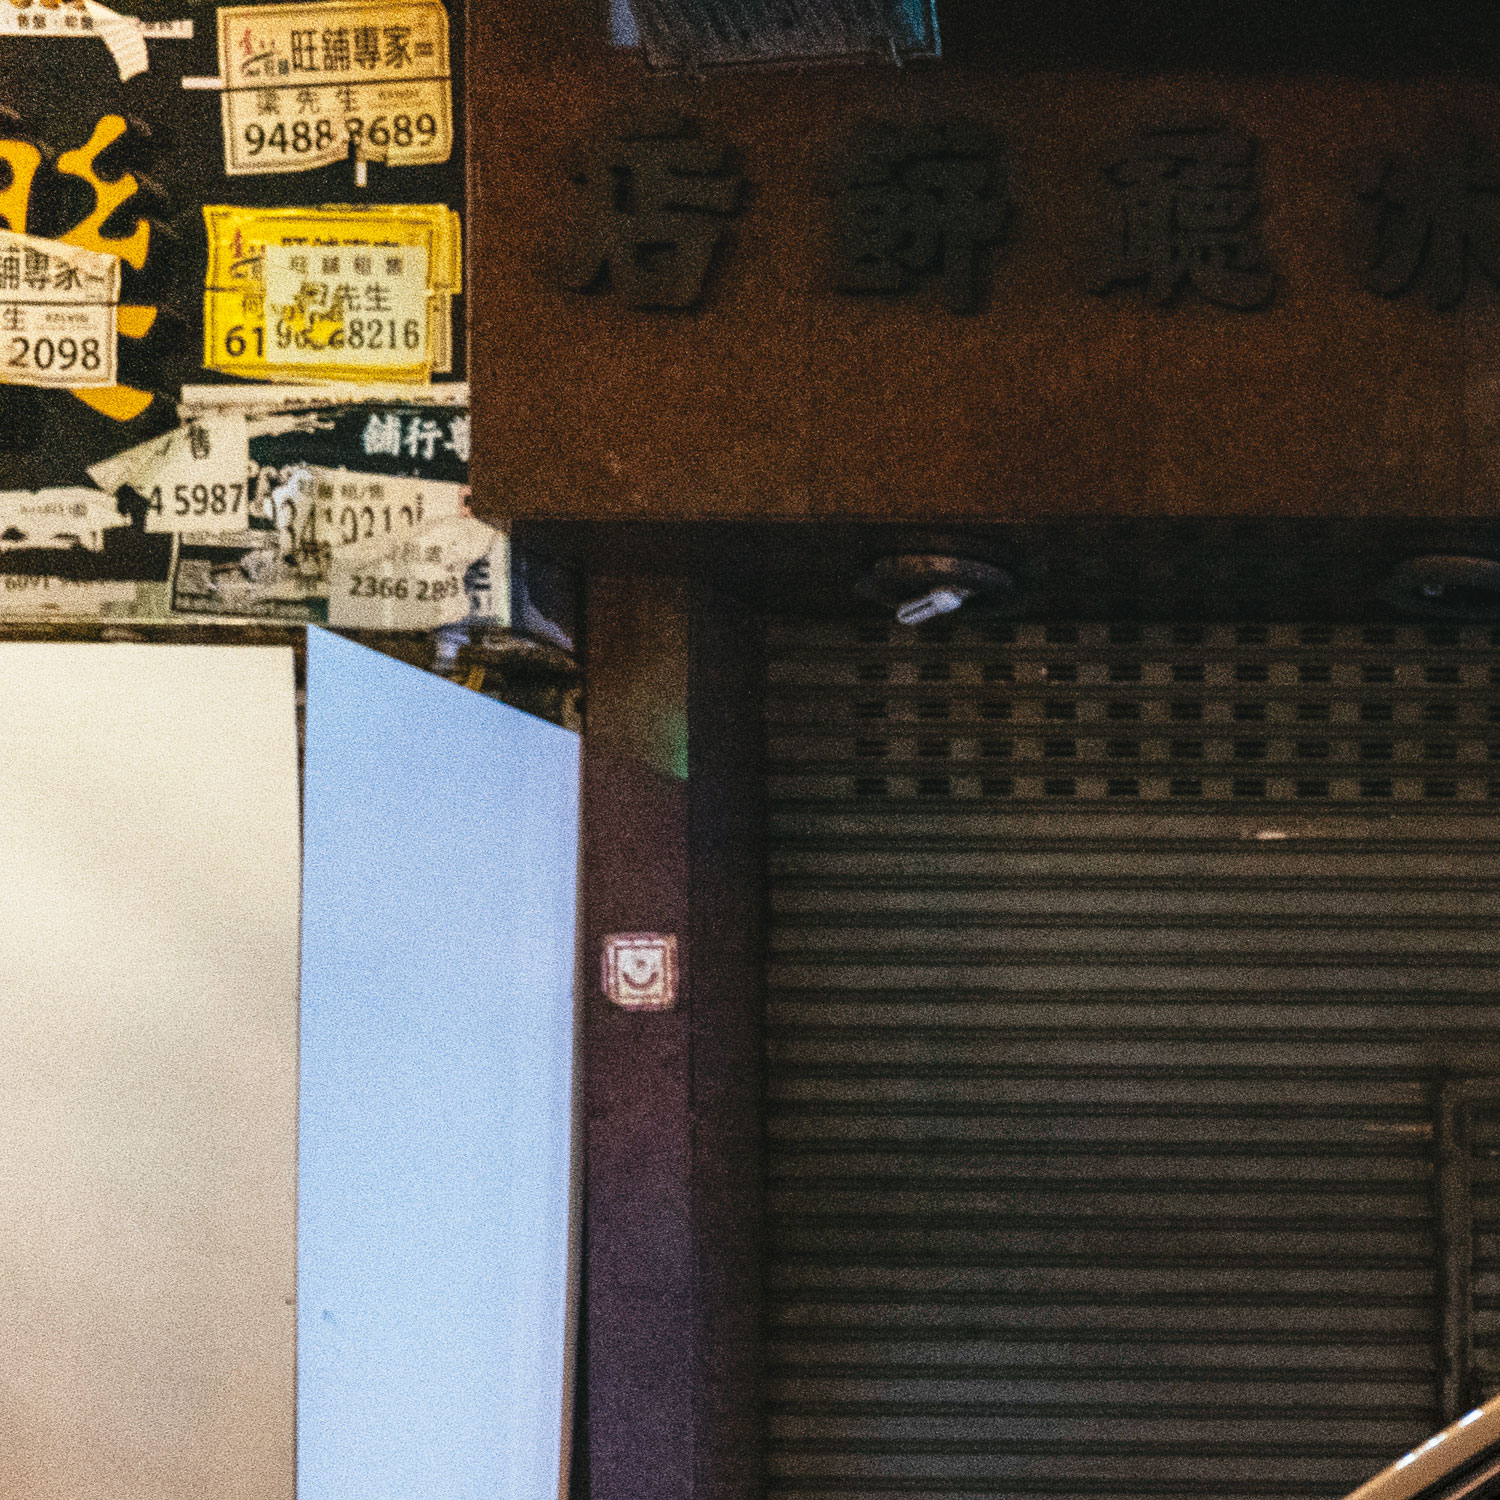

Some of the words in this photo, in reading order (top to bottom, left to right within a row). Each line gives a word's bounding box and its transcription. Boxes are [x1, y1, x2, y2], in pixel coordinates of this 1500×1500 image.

[245, 119, 333, 156] 9488
[7, 336, 101, 370] 2098
[174, 483, 244, 516] 5987
